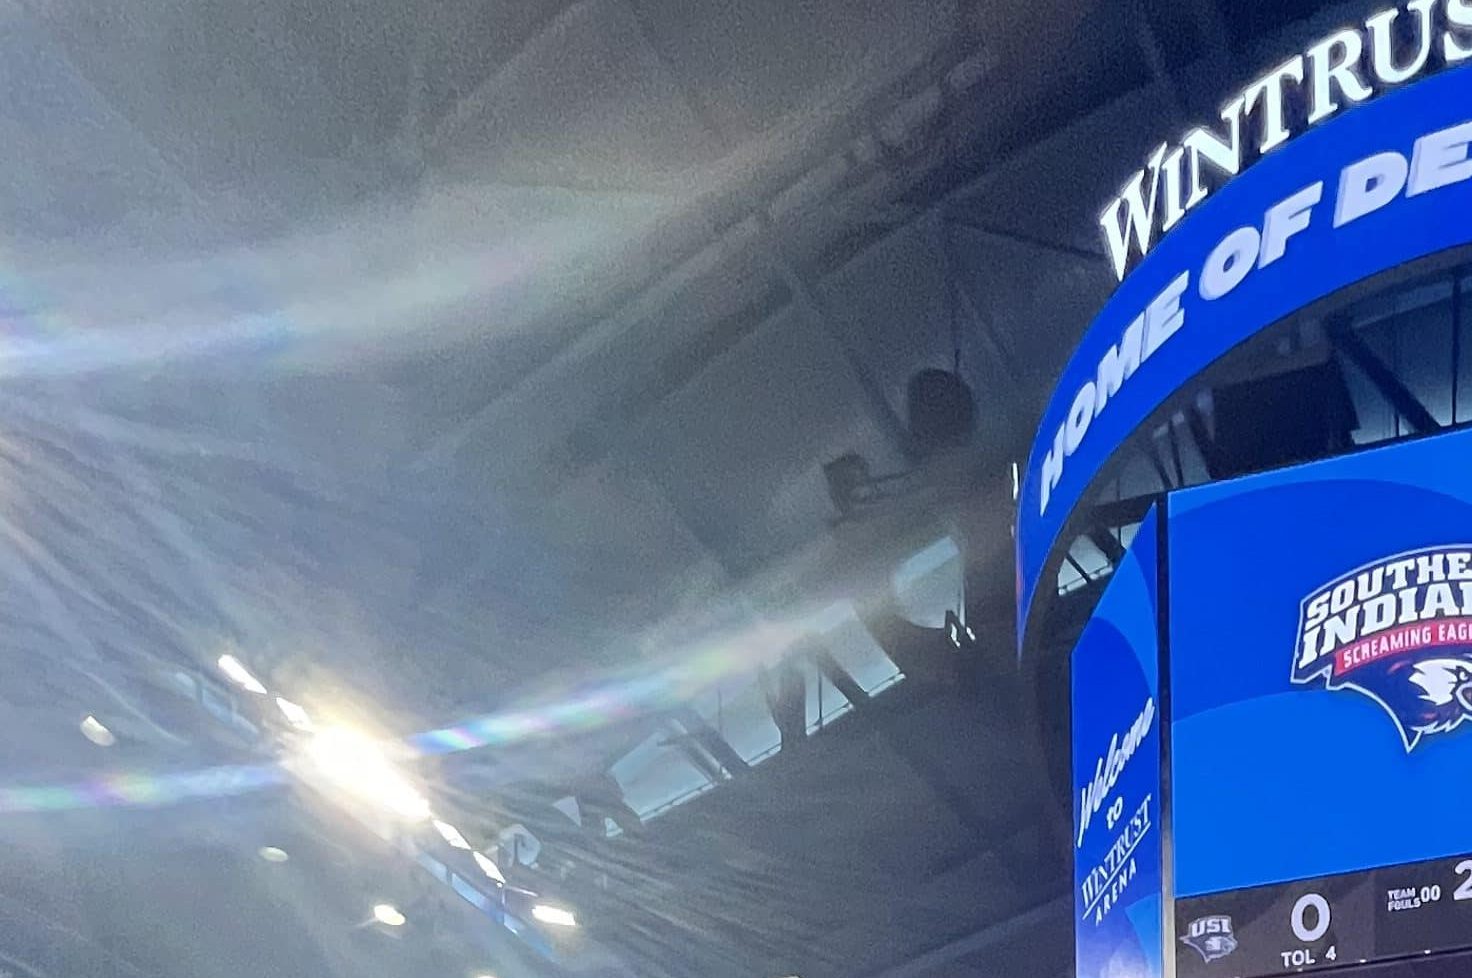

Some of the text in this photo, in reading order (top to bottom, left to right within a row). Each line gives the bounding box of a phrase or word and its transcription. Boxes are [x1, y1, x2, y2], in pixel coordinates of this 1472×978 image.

[1040, 270, 1189, 515] HOME
[1199, 182, 1322, 300] OF
[1343, 626, 1431, 668] SCREAMING
[1107, 797, 1123, 829] to
[1095, 858, 1137, 926] ARENA
[1388, 887, 1416, 900] TEAM
[1388, 897, 1421, 912] FOULS
[1421, 885, 1441, 902] 00
[1192, 916, 1230, 937] USI
[1290, 894, 1332, 942] 0
[1281, 946, 1337, 968] TOL 4
